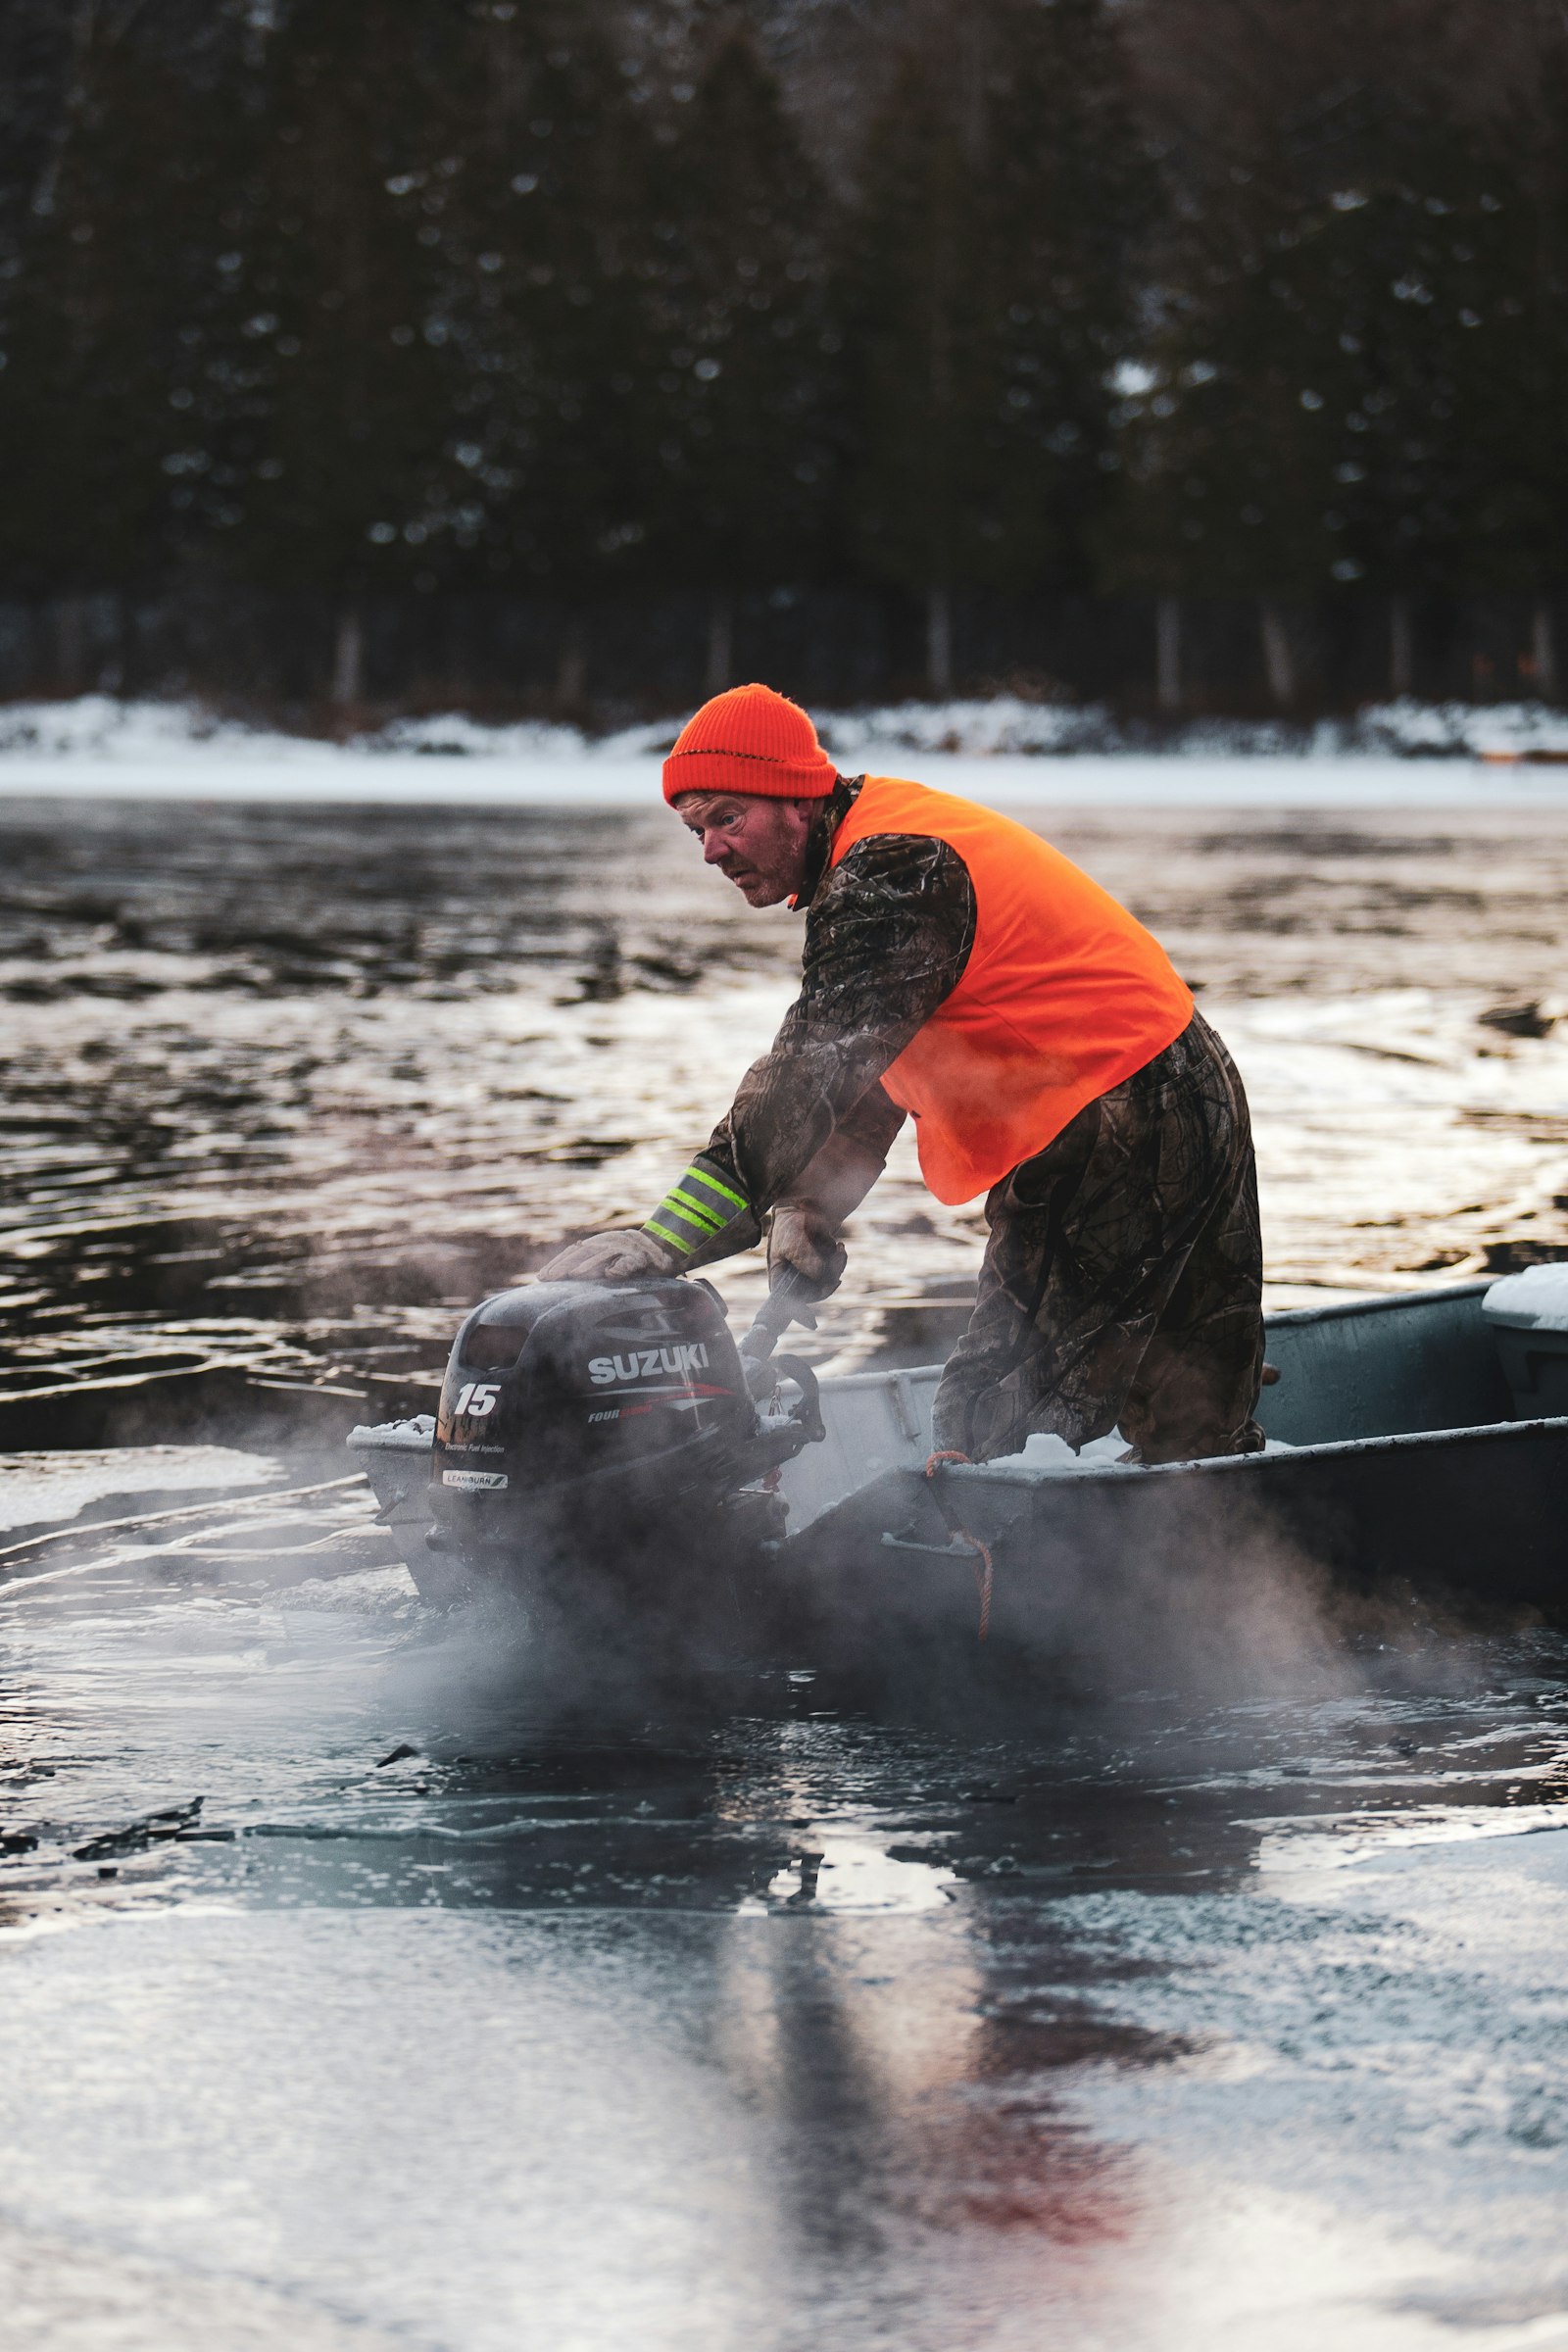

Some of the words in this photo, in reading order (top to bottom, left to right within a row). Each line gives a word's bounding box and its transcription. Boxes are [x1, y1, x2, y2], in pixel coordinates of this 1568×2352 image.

[588, 1343, 710, 1385] SUZUKI
[454, 1383, 502, 1417] 15
[481, 1445, 505, 1454] Injection
[468, 1476, 491, 1485] BURN
